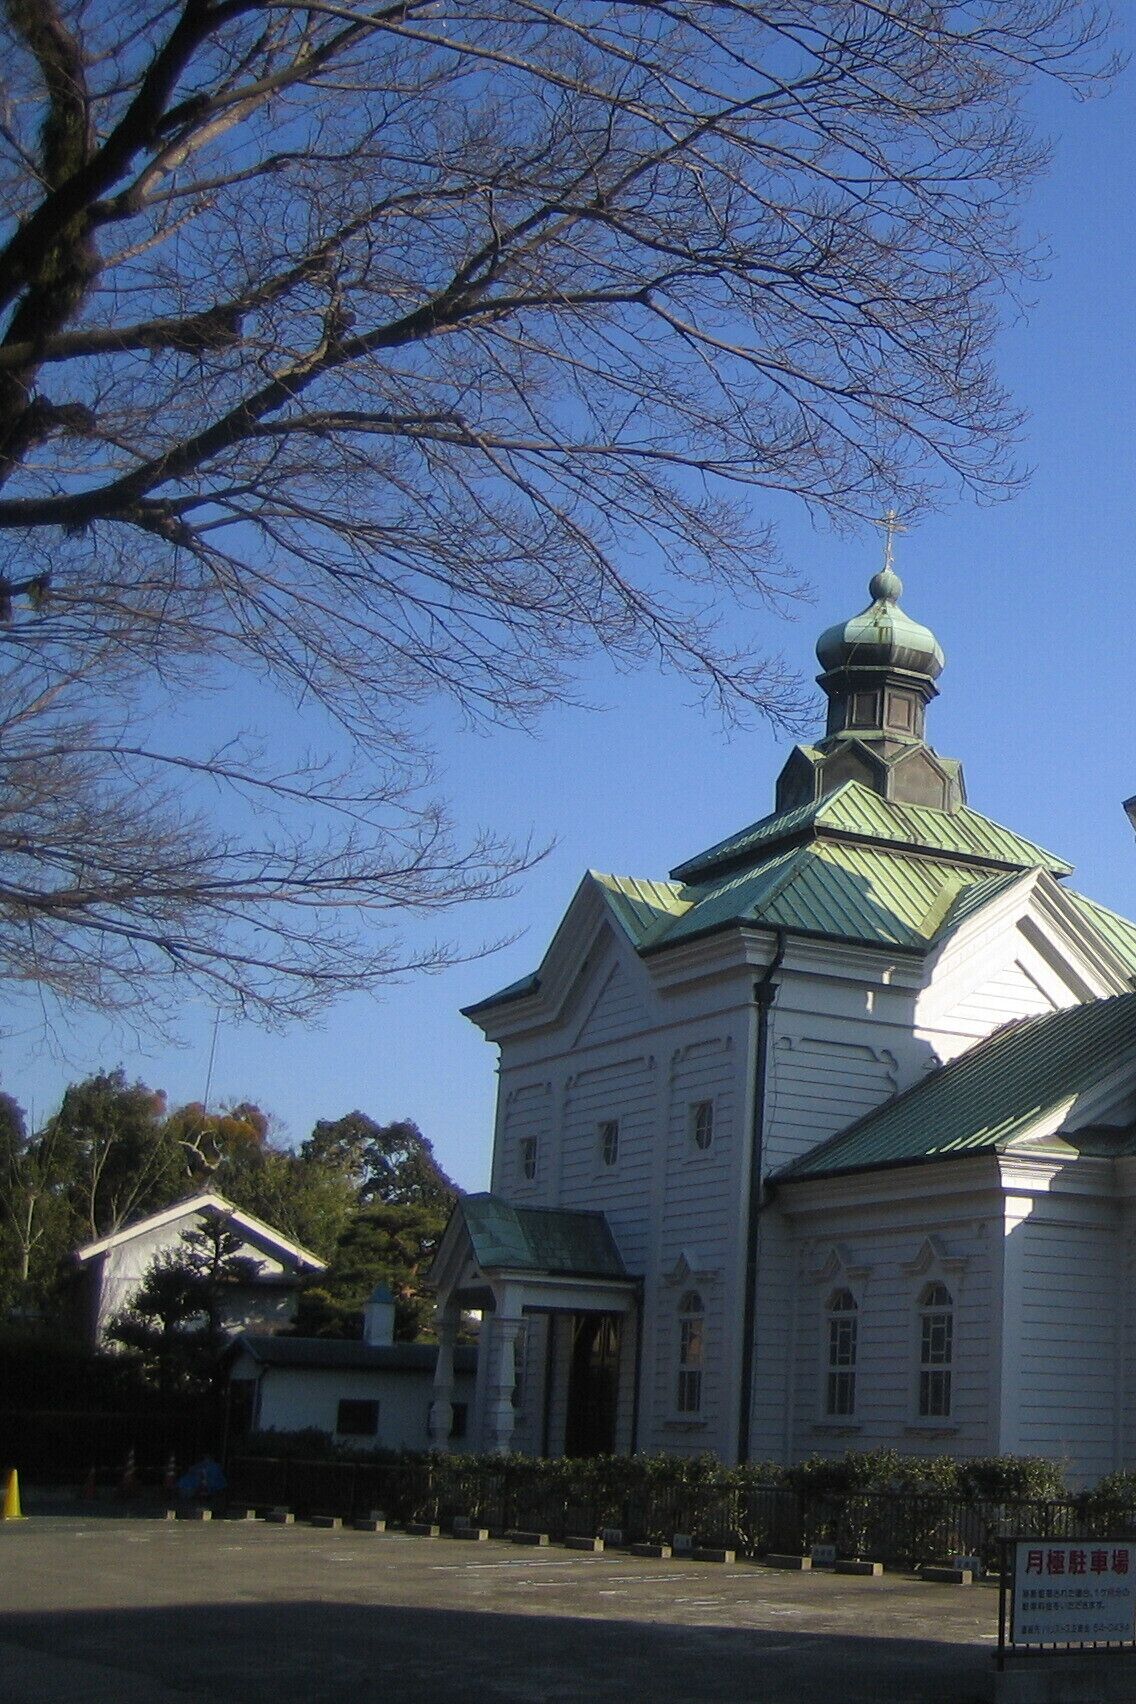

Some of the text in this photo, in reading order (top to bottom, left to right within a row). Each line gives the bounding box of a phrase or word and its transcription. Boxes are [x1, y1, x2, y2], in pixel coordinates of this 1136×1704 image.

[1025, 1549, 1130, 1575] 月極駐車場
